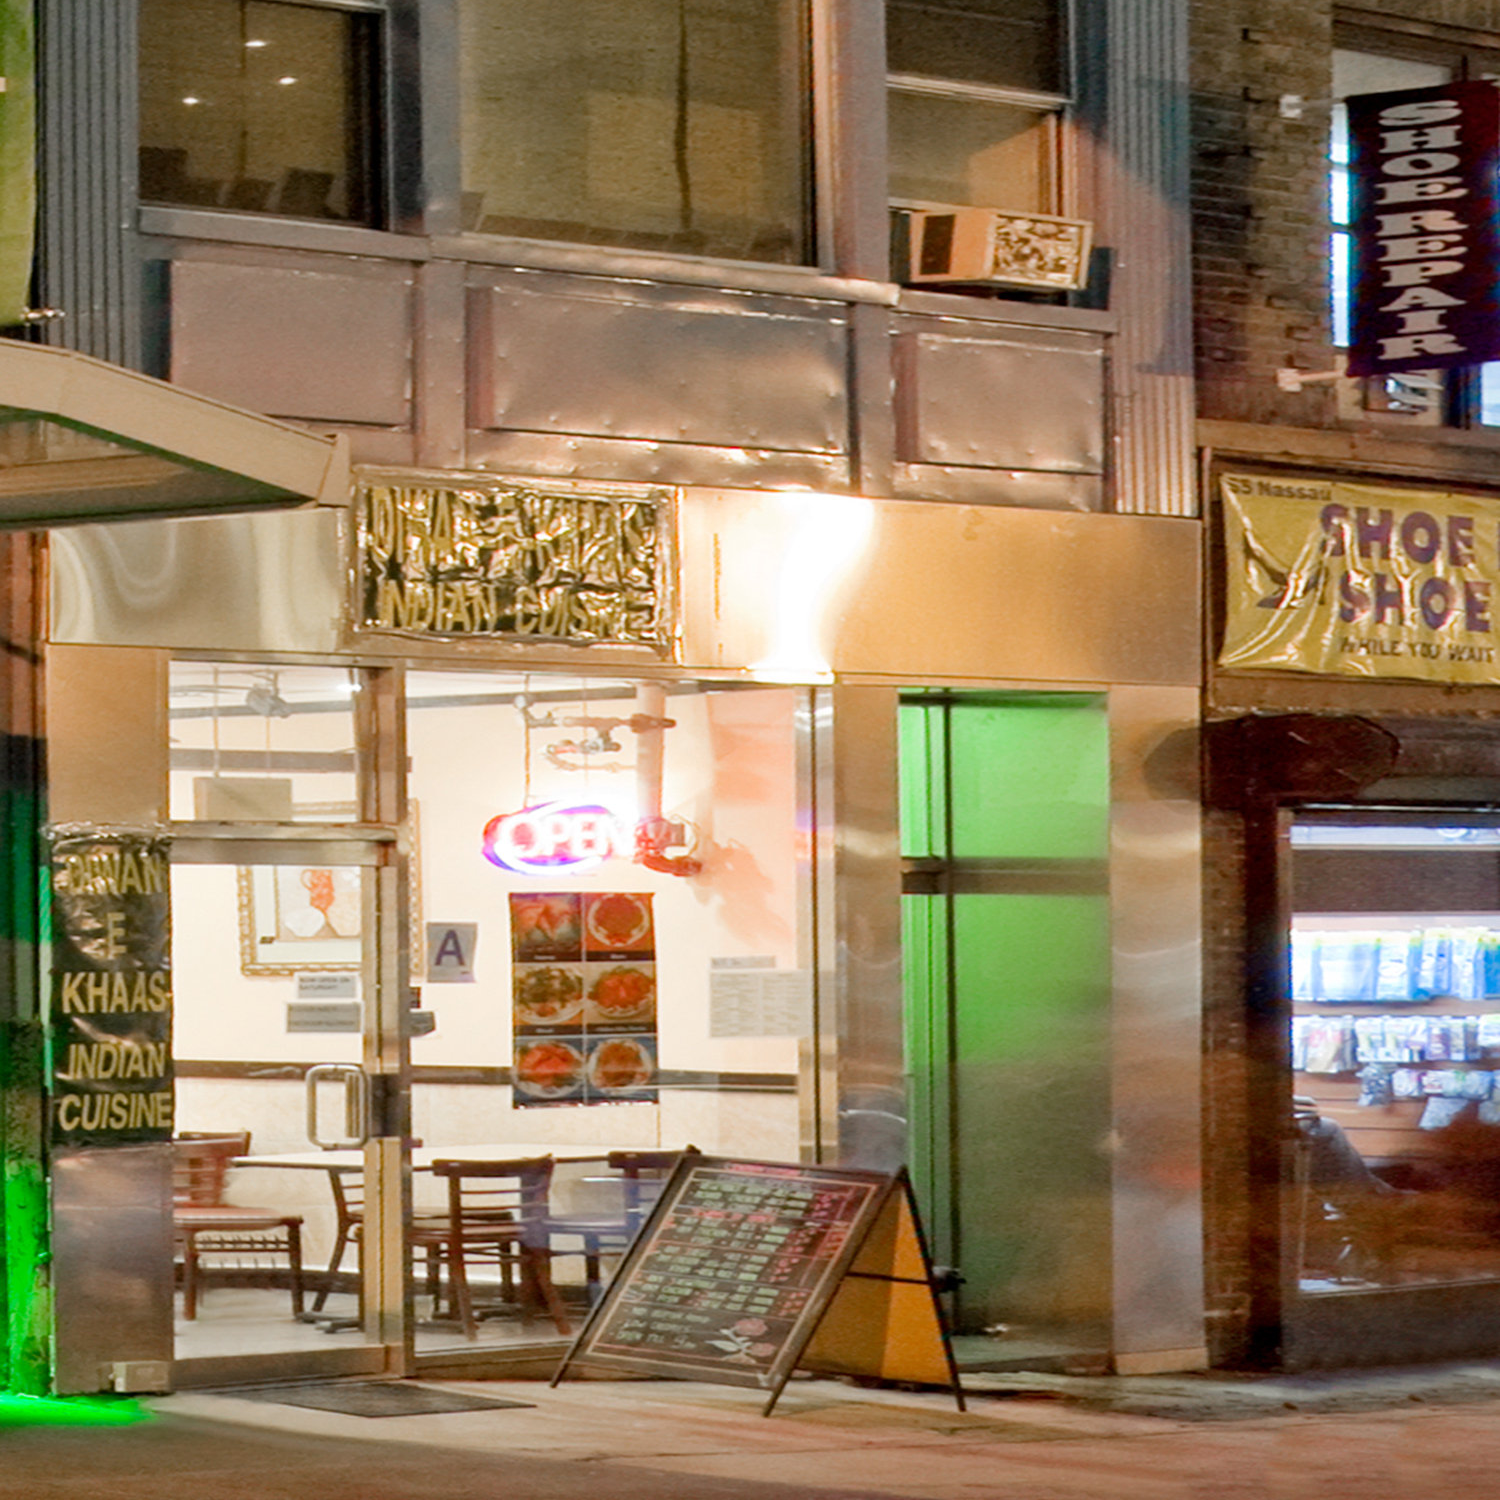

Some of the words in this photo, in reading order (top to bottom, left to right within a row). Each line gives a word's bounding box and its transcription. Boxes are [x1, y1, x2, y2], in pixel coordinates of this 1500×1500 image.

[1376, 100, 1470, 205] SHOE
[1375, 209, 1469, 360] REPAIR
[1257, 481, 1332, 501] Nassau
[1321, 503, 1474, 567] SHOE
[1339, 570, 1491, 632] SHOE
[434, 929, 466, 966] A
[62, 971, 168, 1014] KHAAS
[69, 1043, 165, 1080] INDIAN
[58, 1092, 173, 1131] CUISINE
